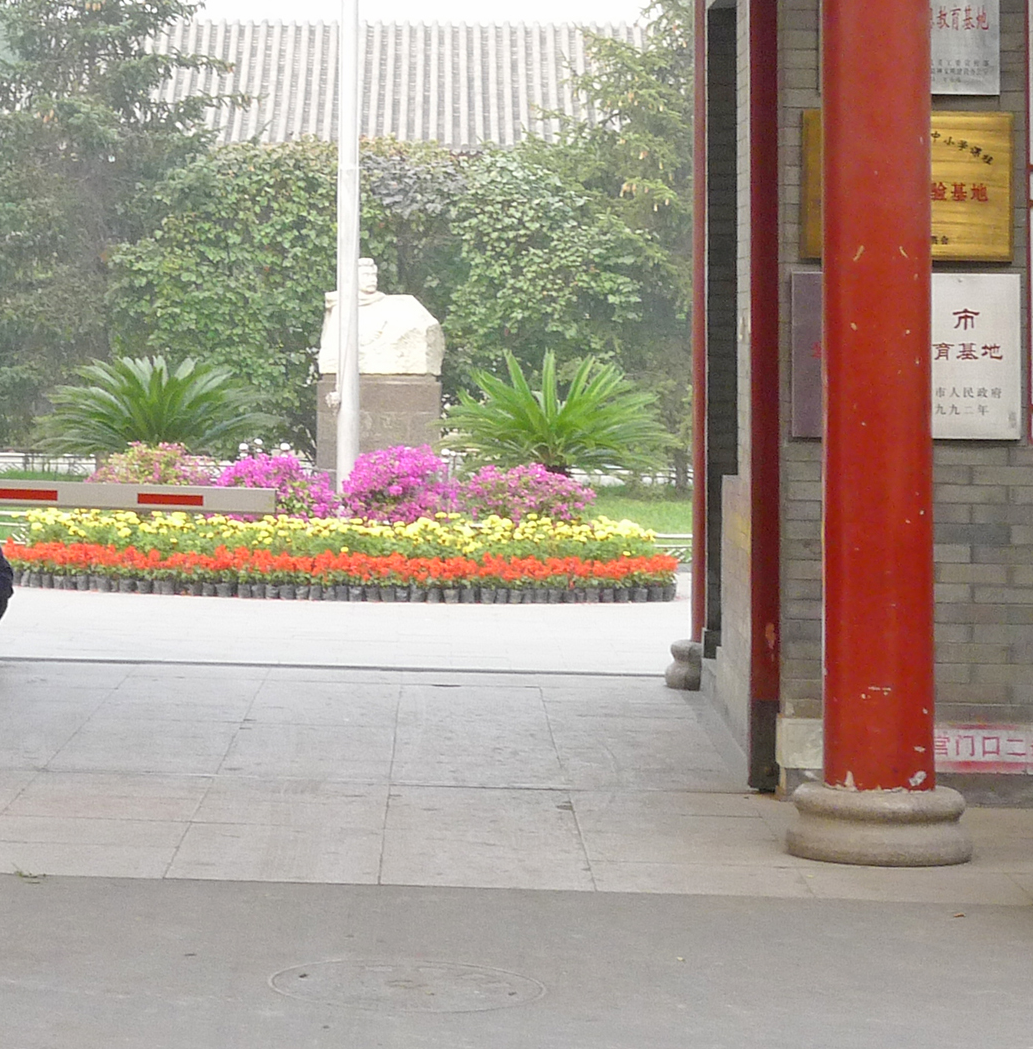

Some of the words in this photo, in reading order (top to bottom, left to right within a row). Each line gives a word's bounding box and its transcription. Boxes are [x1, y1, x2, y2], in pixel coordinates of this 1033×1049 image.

[929, 4, 990, 31] 教育基地
[952, 308, 980, 330] 市
[932, 342, 1003, 361] 育基地
[935, 386, 1002, 399] 市人民政府
[934, 734, 1033, 758] 宫门口二
